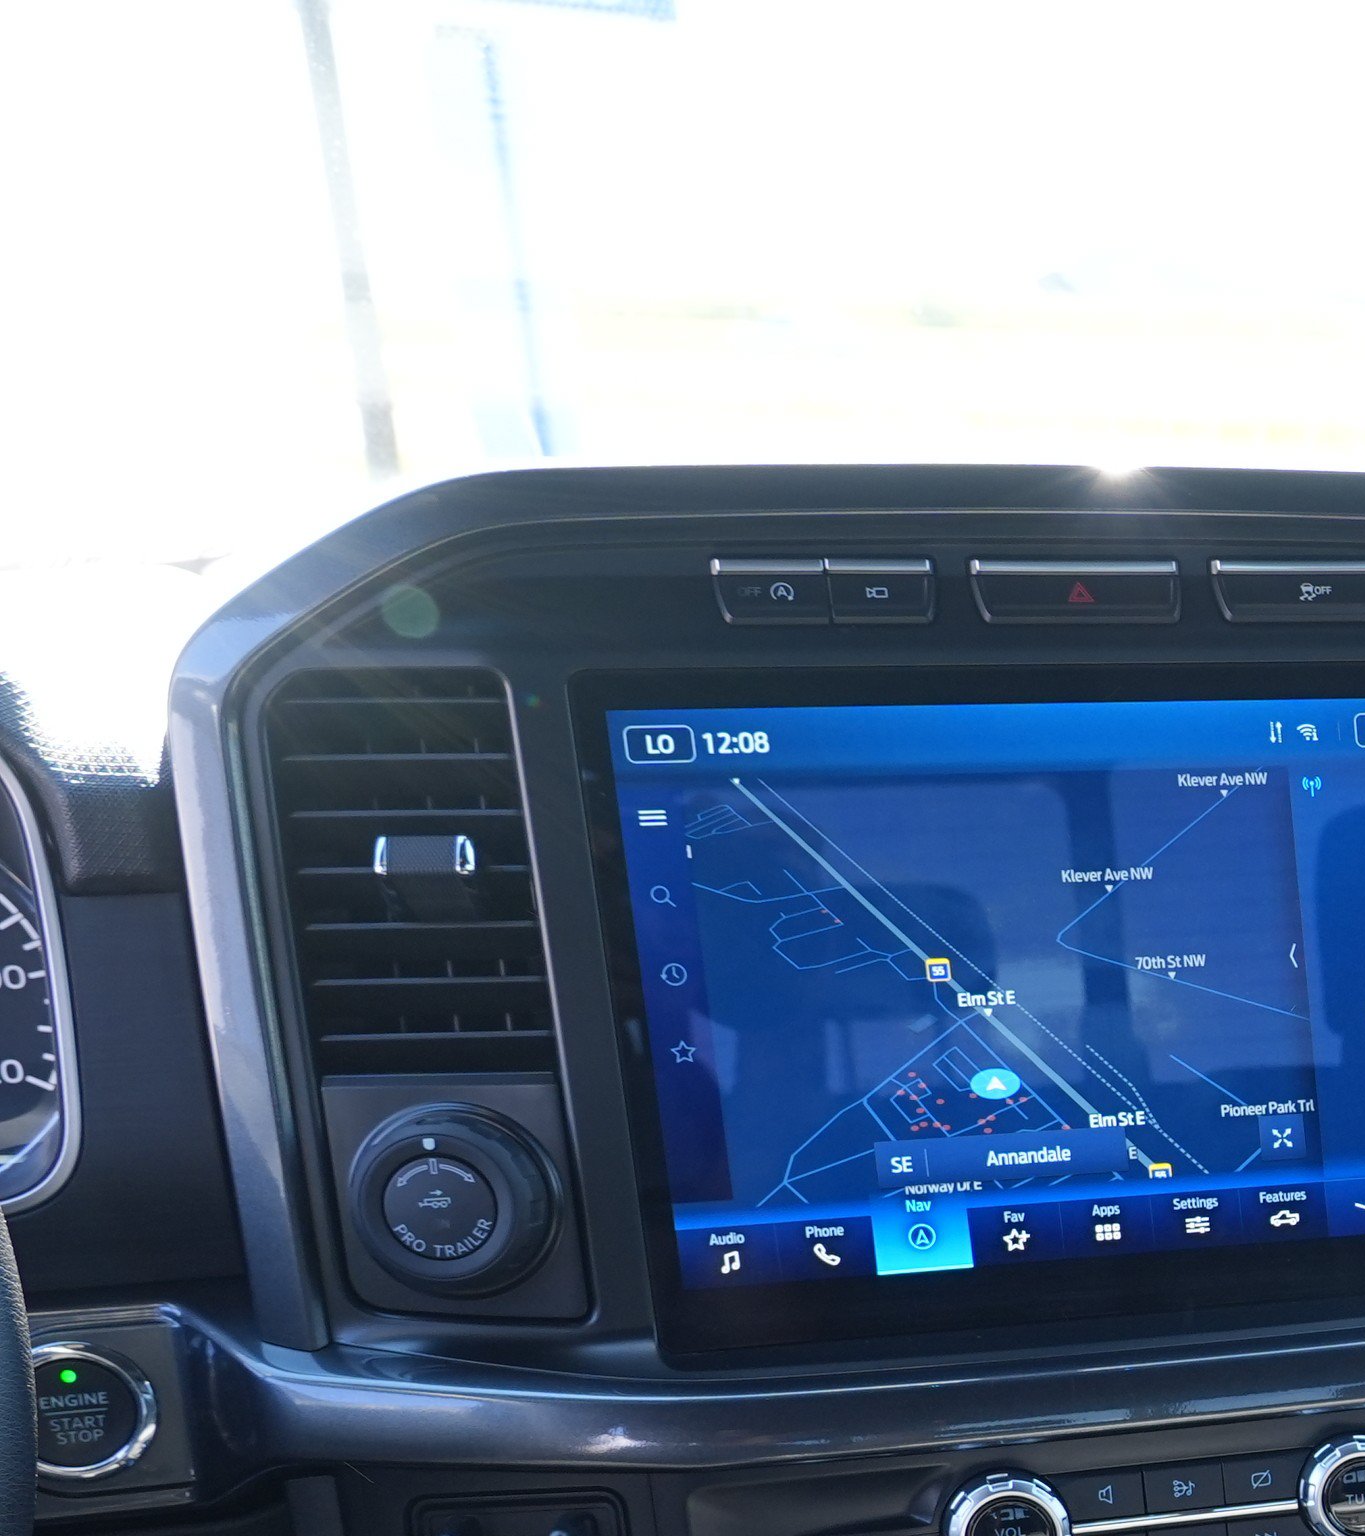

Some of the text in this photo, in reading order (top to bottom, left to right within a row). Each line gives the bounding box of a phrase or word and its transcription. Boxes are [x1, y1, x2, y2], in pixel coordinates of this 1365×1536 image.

[1314, 586, 1333, 595] OFF
[645, 731, 770, 755] LO 12:08
[1178, 771, 1268, 787] Klever Ave NW
[1062, 866, 1153, 883] Klever Ave NW
[1135, 954, 1205, 969] 70th St NW
[932, 966, 946, 977] 55
[957, 990, 1015, 1008] Elm St E
[1220, 1098, 1316, 1118] Pioneer Park Trl
[1089, 1110, 1145, 1128] Elm St E
[891, 1145, 1072, 1174] SE Annandale
[1173, 1195, 1219, 1212] Settings
[1259, 1189, 1307, 1204] Features
[905, 1199, 931, 1212] Nav
[1092, 1202, 1120, 1218] Apps
[1004, 1210, 1025, 1223] Fav
[392, 1218, 493, 1258] PRO TRAILER
[709, 1231, 745, 1247] Audio
[805, 1224, 844, 1239] Phone
[39, 1391, 109, 1410] ENGINE
[50, 1415, 106, 1432] START
[56, 1429, 104, 1445] STOP
